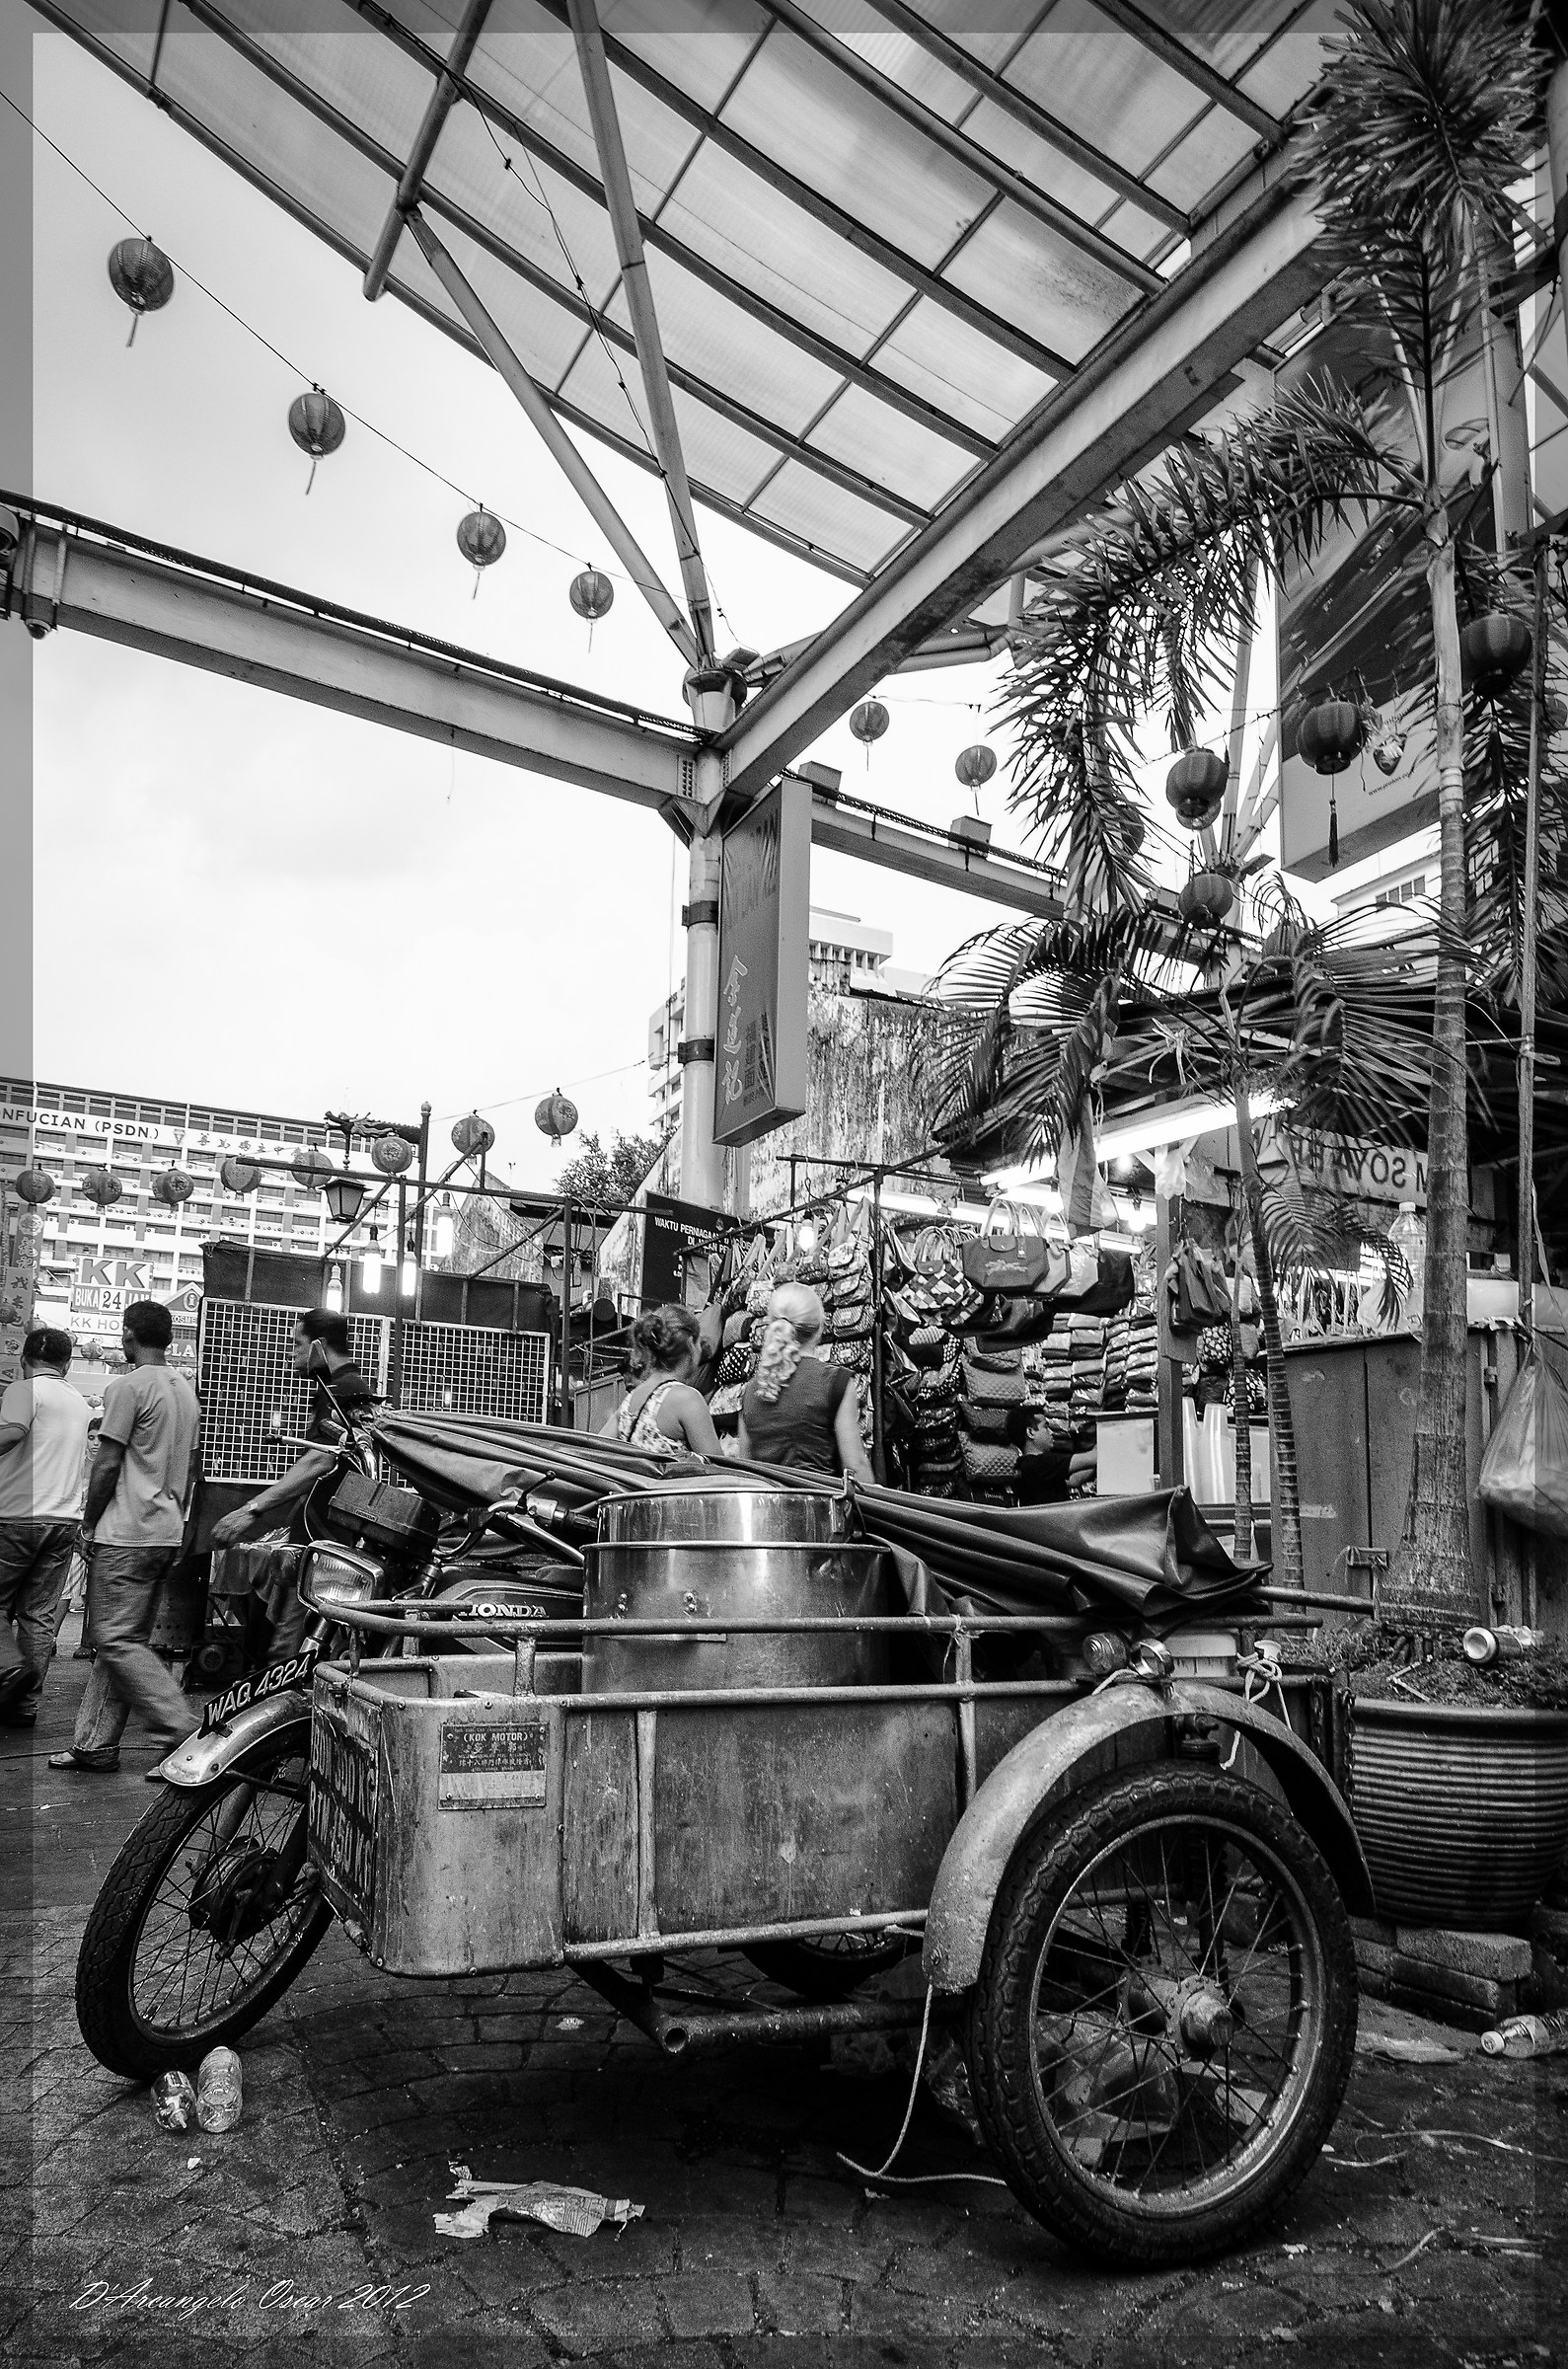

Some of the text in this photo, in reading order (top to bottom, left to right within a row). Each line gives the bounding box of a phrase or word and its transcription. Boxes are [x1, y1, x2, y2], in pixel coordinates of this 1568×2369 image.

[654, 1216, 679, 1232] WAKTU
[680, 1222, 720, 1241] PERNIAGAA
[81, 1258, 147, 1288] KK
[75, 1288, 99, 1308] BUKA
[102, 1290, 121, 1310] 24
[71, 1317, 92, 1329] KK
[254, 1653, 311, 1697] 4324
[491, 1731, 528, 1741] MOTOR)
